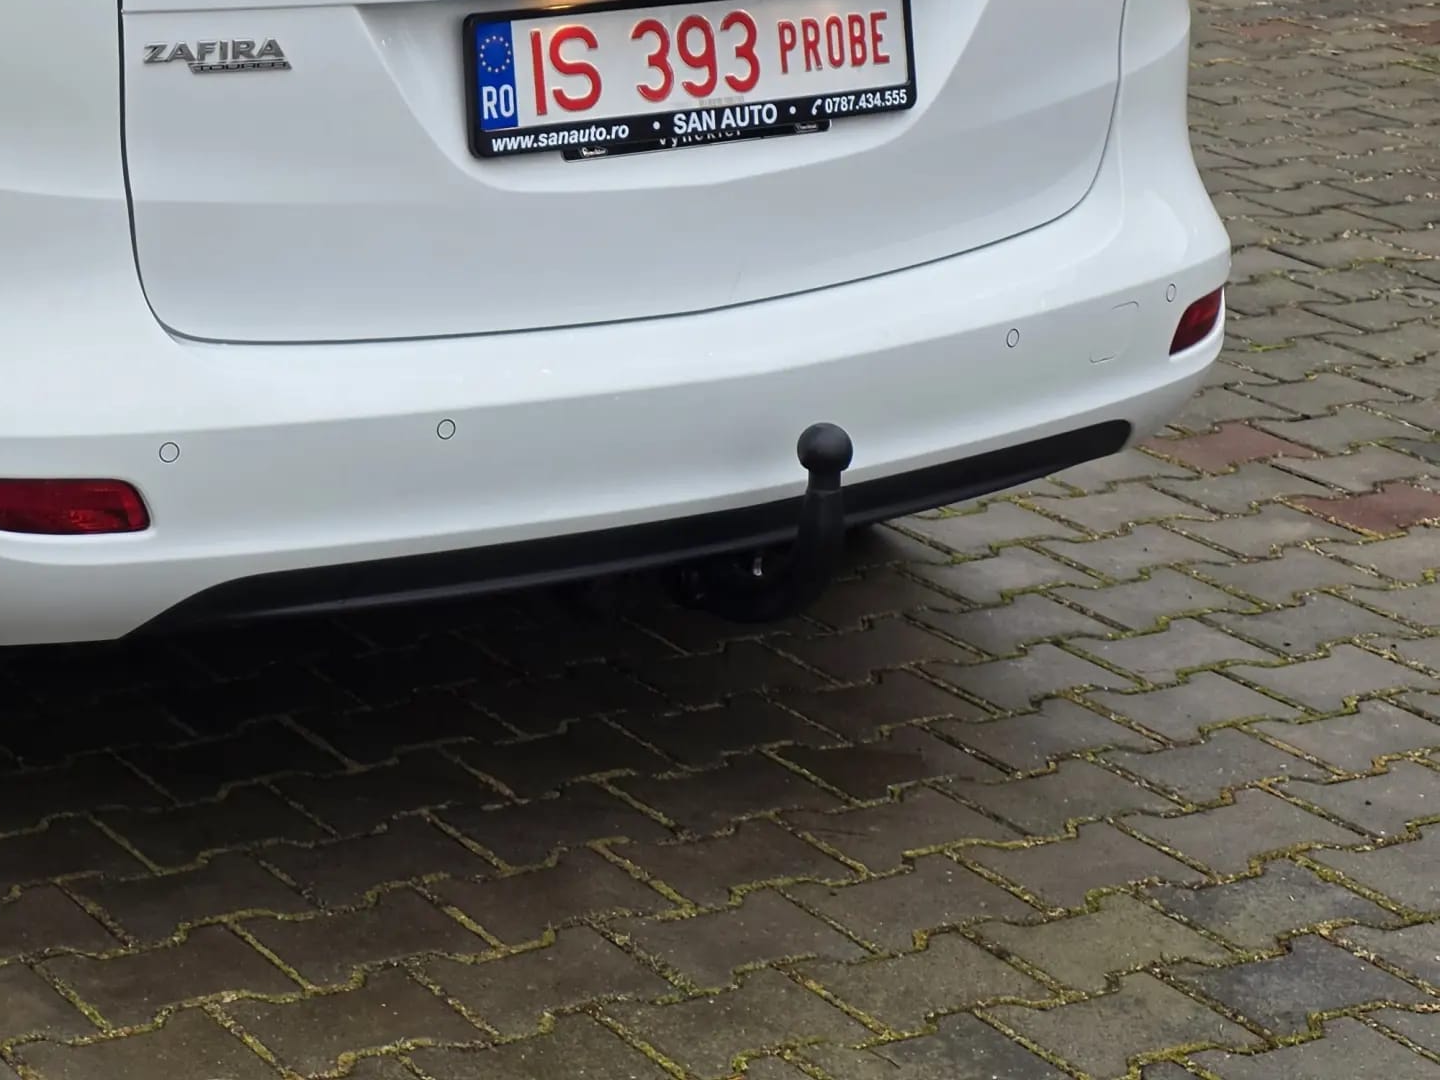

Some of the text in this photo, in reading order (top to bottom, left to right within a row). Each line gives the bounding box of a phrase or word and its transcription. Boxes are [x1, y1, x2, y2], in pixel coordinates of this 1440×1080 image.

[143, 37, 286, 64] ZAFIRA
[529, 9, 890, 116] IS 393 PROBE
[482, 84, 515, 120] RO
[491, 122, 629, 152] www.sanauto.ro
[673, 112, 717, 135] SAN
[721, 103, 778, 130] AUTO
[824, 88, 908, 114] 0787.434.555
